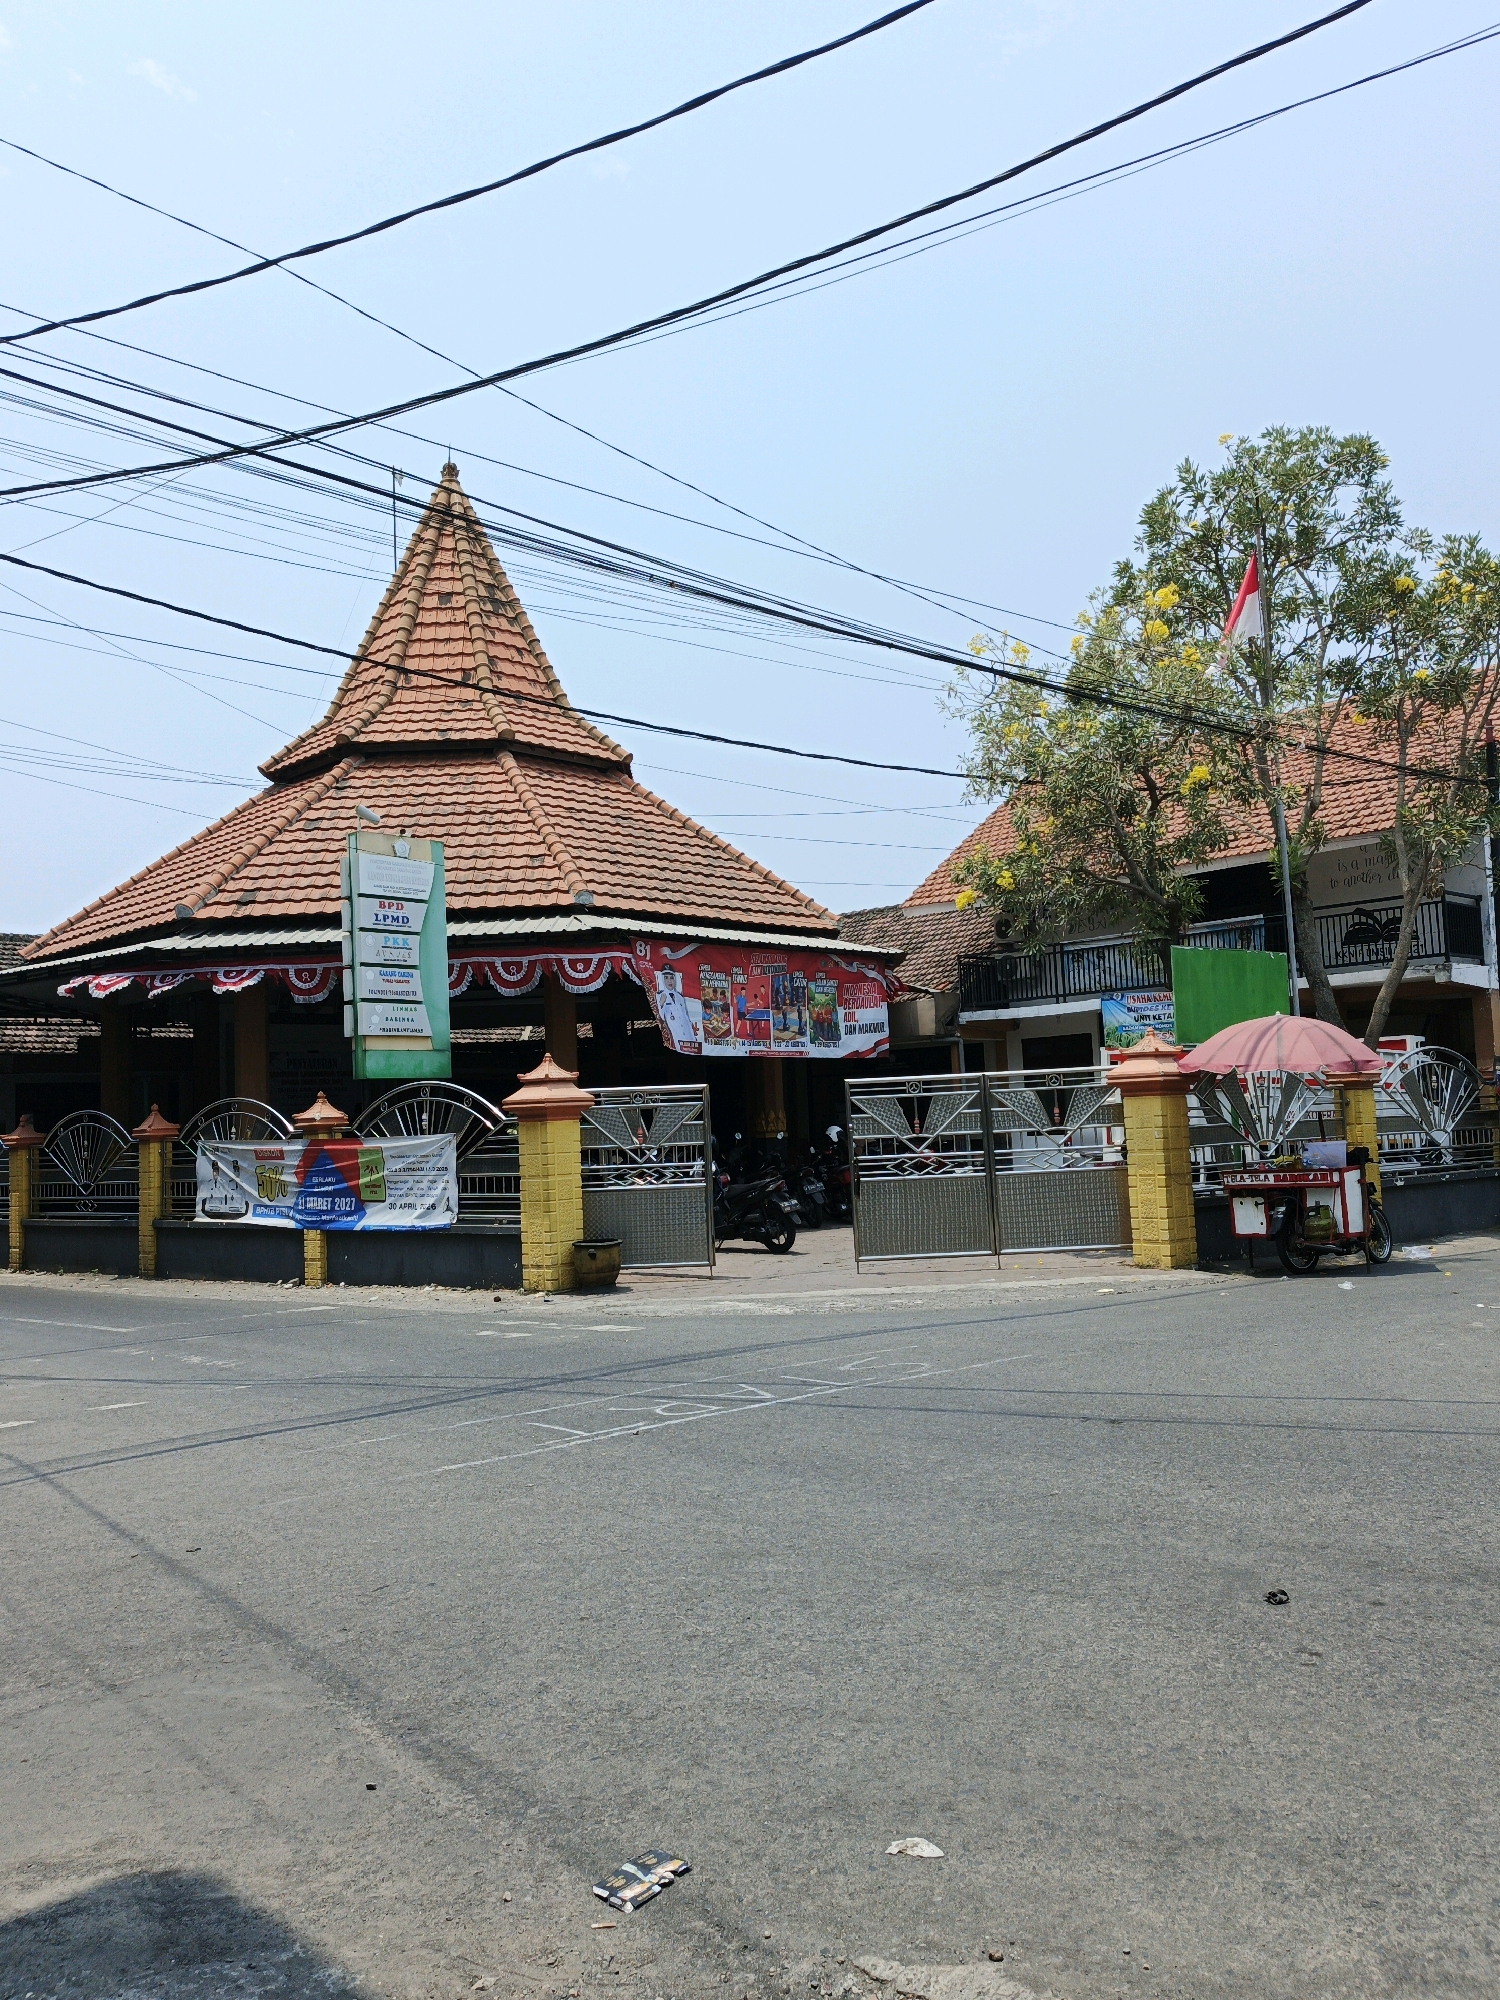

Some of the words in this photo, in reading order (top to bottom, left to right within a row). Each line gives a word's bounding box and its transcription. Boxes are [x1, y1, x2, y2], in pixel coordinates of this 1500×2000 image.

[1337, 858, 1348, 872] is
[1330, 877, 1339, 889] to
[378, 900, 405, 911] BPD
[373, 912, 411, 925] LPMD
[383, 935, 410, 947] PKK
[636, 940, 651, 960] 81
[843, 982, 878, 996] INDONESIA
[1126, 993, 1152, 1004] USAHA
[1134, 1014, 1151, 1022] UNIT
[844, 1024, 857, 1036] DAN
[258, 1149, 281, 1157] DISKON
[254, 1164, 289, 1202] 50%
[1272, 1172, 1330, 1183] BAROKAH
[306, 1196, 332, 1211] MARET
[334, 1197, 356, 1211] 2027
[388, 1202, 398, 1210] 30
[398, 1202, 418, 1211] APRIL
